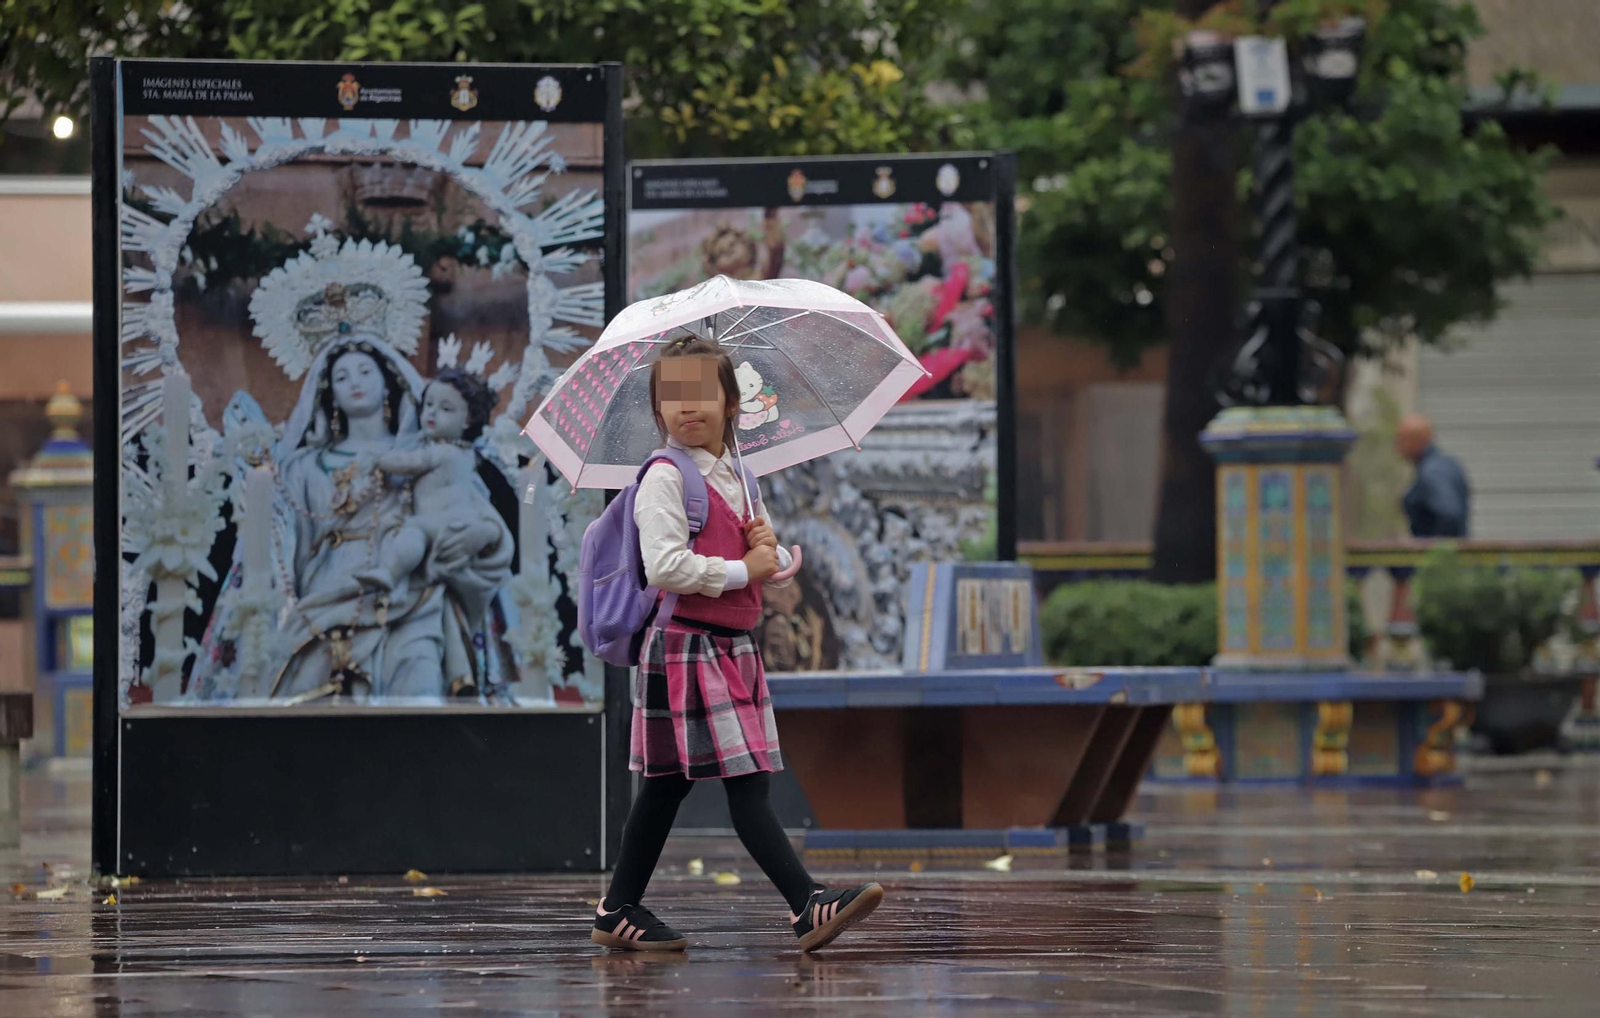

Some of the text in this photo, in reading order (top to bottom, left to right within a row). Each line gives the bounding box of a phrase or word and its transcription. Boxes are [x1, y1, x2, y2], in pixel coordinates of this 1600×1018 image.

[192, 79, 242, 90] ESPECIALES
[195, 90, 207, 101] DE
[209, 90, 222, 101] LA
[223, 91, 254, 101] PALMA
